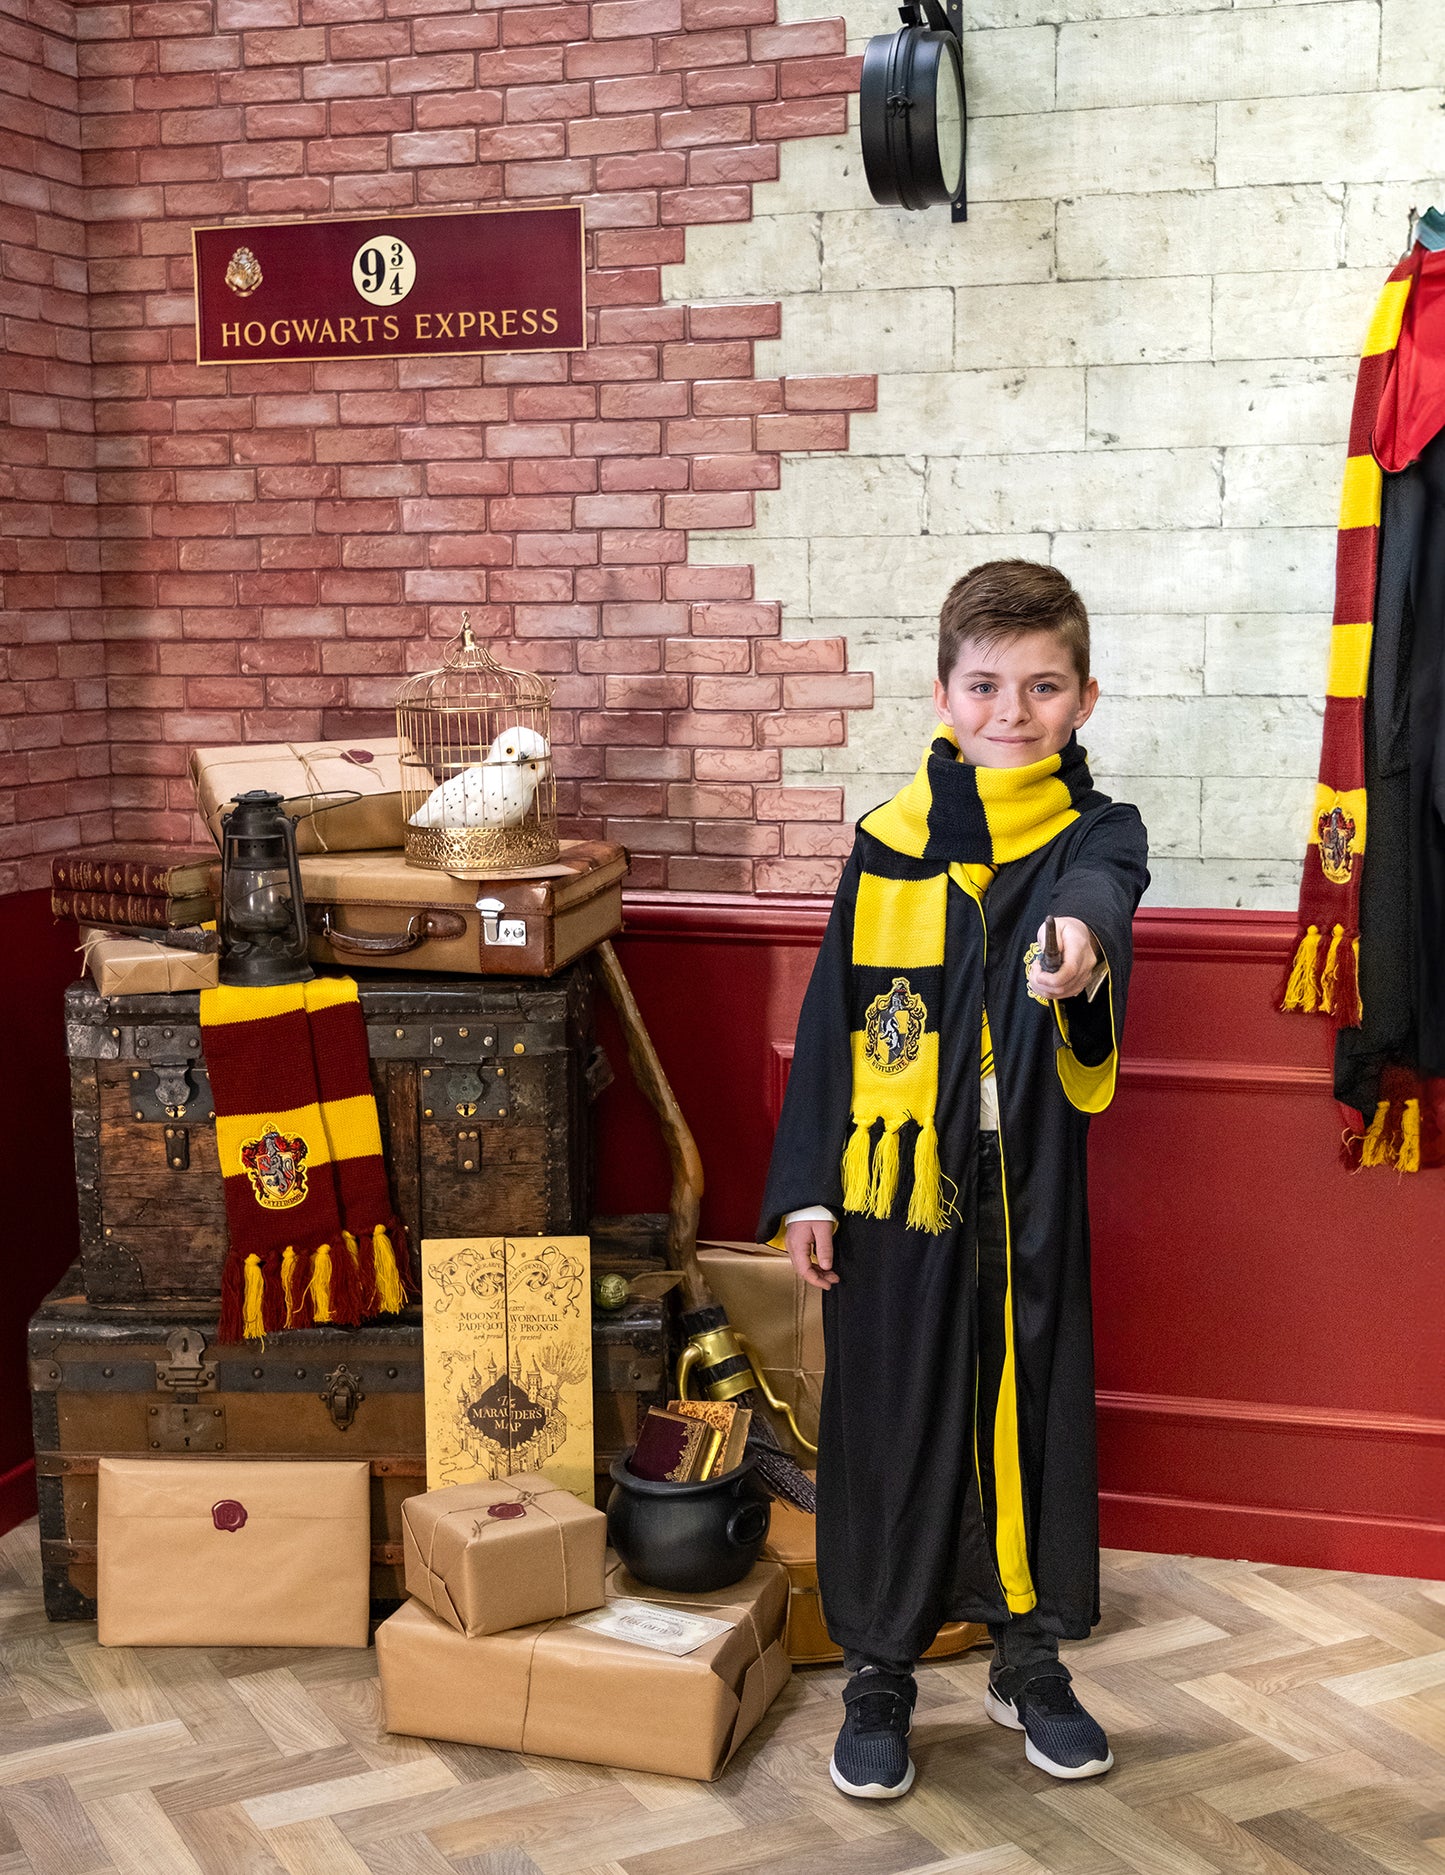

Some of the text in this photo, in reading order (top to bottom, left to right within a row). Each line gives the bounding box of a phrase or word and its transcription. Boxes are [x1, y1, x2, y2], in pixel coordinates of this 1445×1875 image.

[221, 308, 559, 347] HOGWARTS EXPRESS
[459, 1312, 560, 1322] MOONY WORMTAIL
[458, 1322, 504, 1332] PADFOOT
[520, 1324, 559, 1332] PRONGS
[472, 1407, 543, 1420] MARAUDER'S
[495, 1420, 521, 1432] MAP
